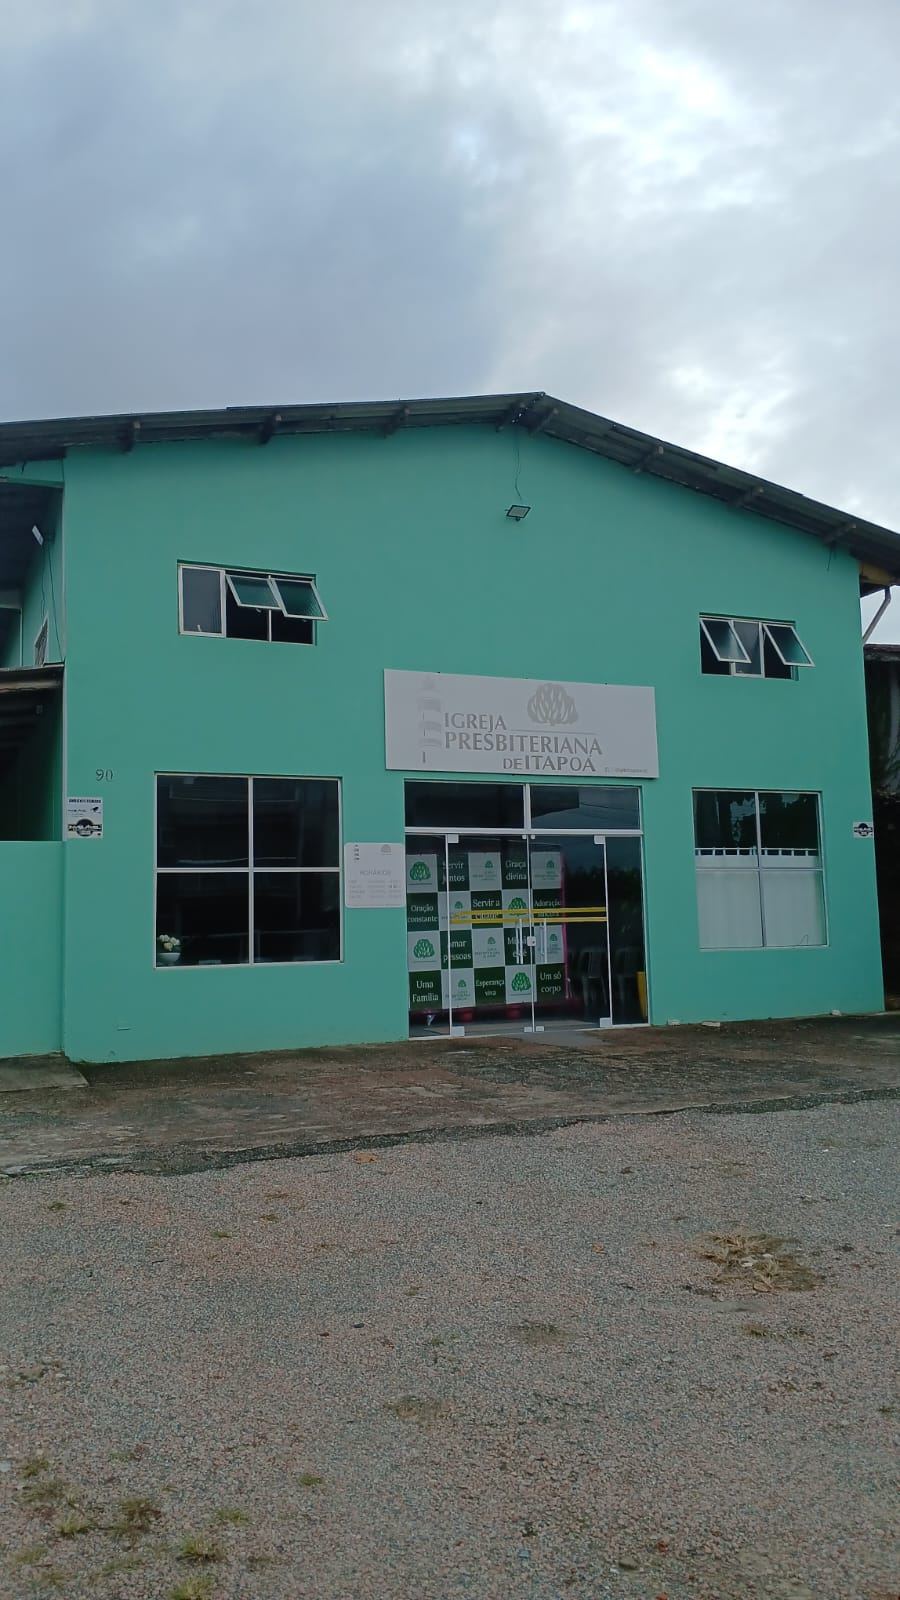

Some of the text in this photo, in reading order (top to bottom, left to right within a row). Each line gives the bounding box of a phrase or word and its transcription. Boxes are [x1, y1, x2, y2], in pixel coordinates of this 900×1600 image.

[444, 712, 508, 732] IGREJA
[444, 731, 603, 755] PRESBITERIANA
[503, 757, 523, 770] DE
[524, 754, 596, 772] ITAPOÁ
[95, 769, 113, 782] 90
[505, 860, 526, 869] Graça
[505, 870, 527, 881] divina
[472, 898, 495, 908] Servir
[410, 904, 434, 913] Oração
[407, 915, 438, 923] constante
[447, 940, 467, 948] mar
[539, 972, 552, 981] Um
[416, 980, 434, 989] Uma
[540, 986, 562, 995] corpo
[412, 992, 439, 1003] Família
